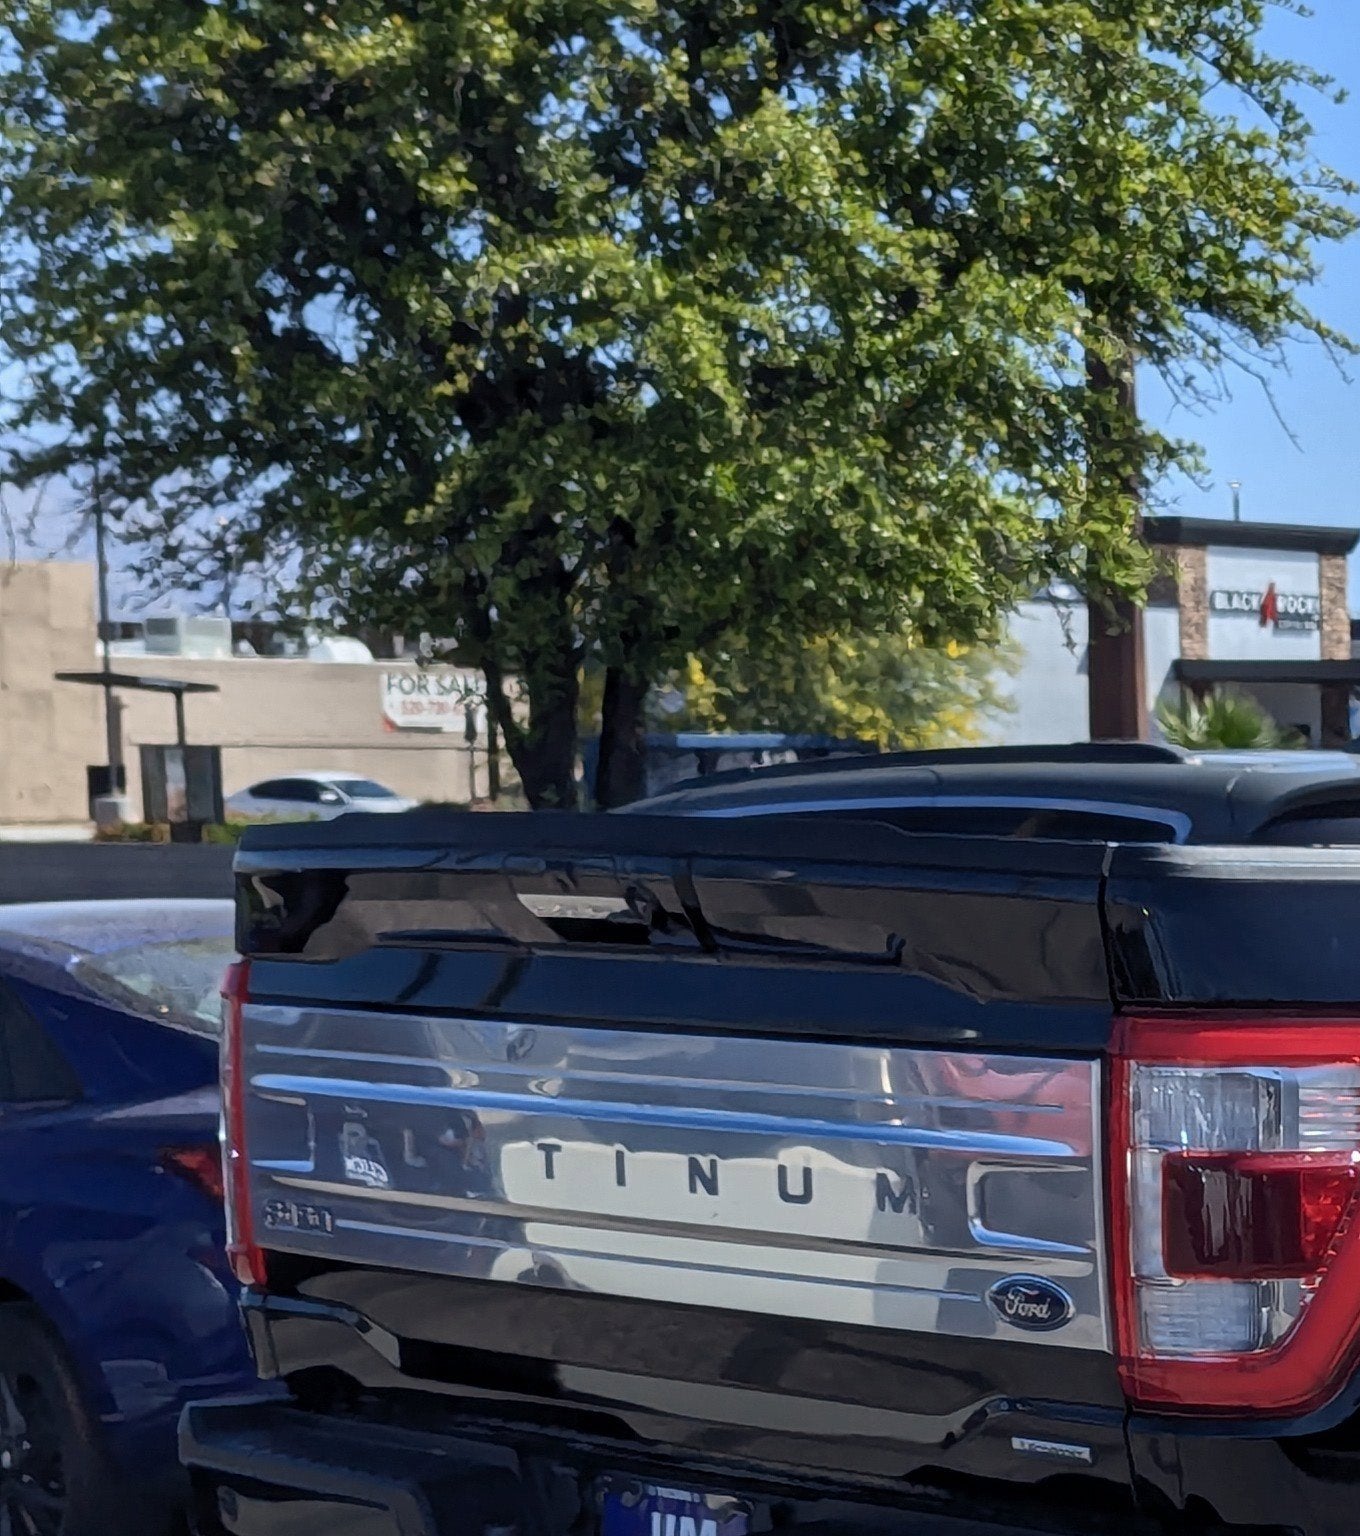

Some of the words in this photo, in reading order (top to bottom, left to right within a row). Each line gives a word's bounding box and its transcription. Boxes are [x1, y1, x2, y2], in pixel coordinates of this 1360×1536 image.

[1210, 590, 1261, 612] BLACK
[387, 671, 430, 695] FOR
[1004, 1286, 1052, 1319] Ford
